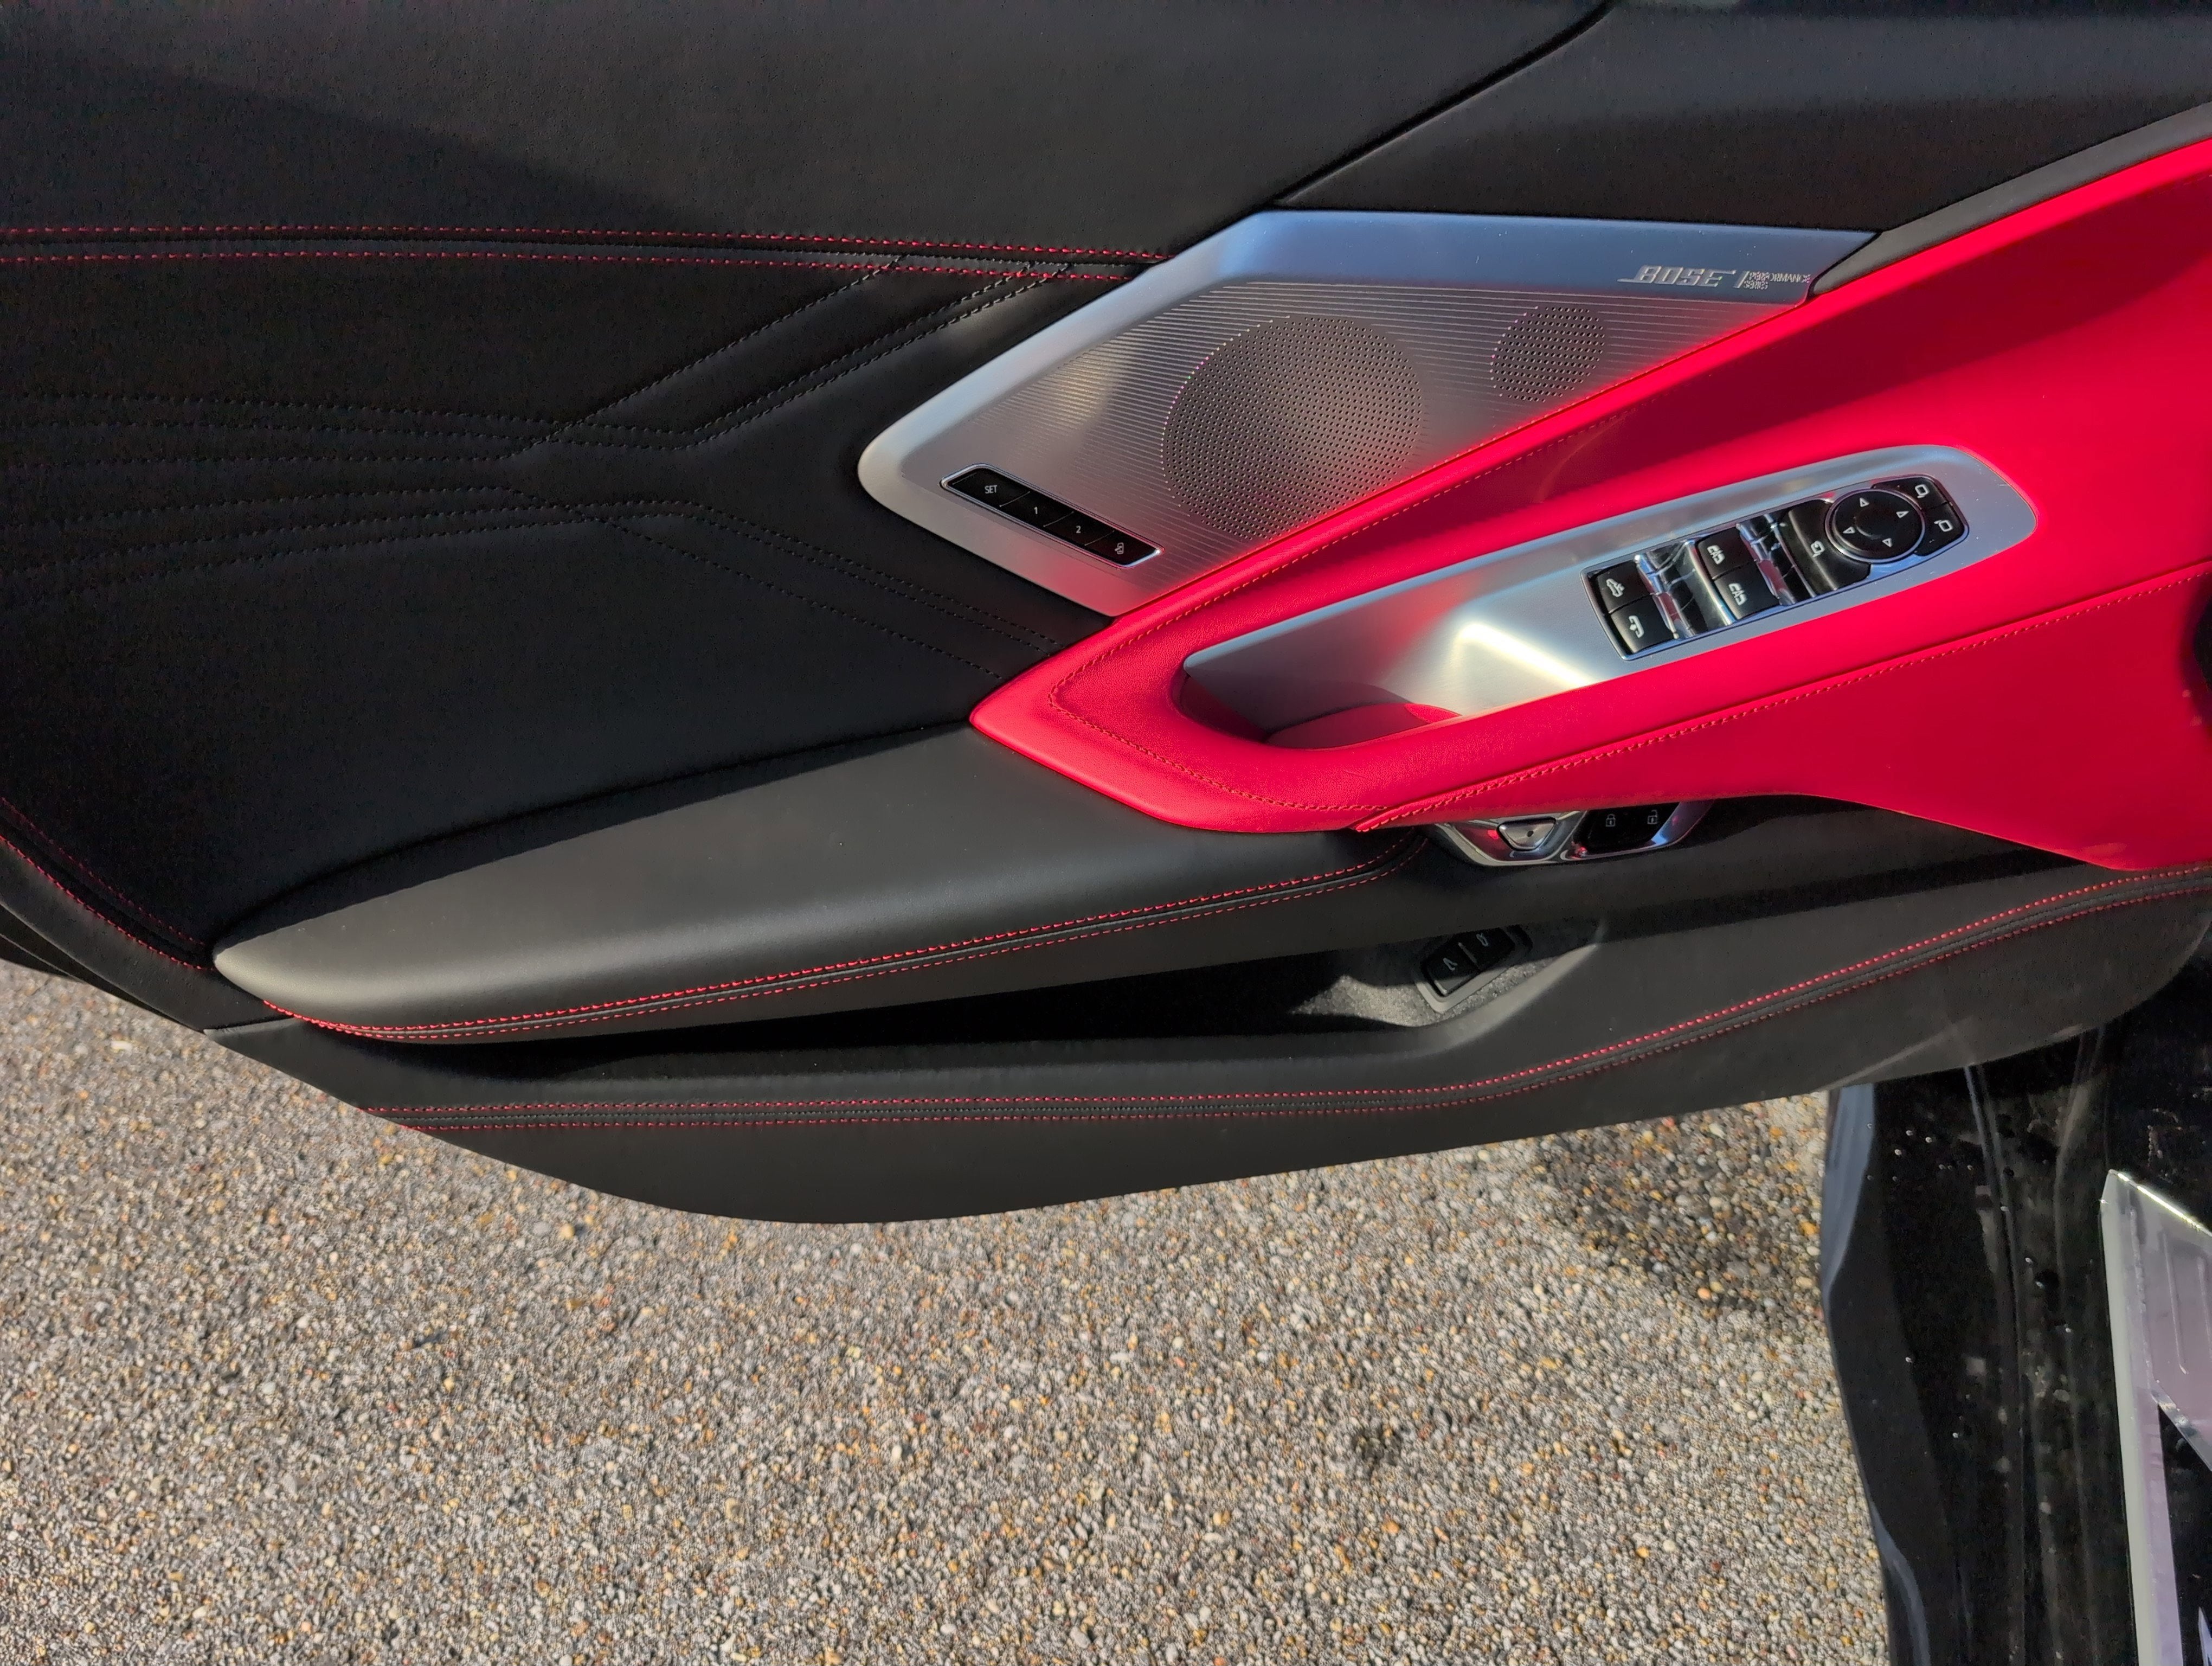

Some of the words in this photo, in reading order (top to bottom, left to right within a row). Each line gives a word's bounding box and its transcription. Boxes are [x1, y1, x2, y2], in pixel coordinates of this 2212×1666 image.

[1617, 265, 1736, 287] BOSE
[1743, 280, 1769, 290] SERIES
[985, 485, 998, 494] SET
[1034, 507, 1038, 515] 1
[1076, 526, 1081, 534] 2
